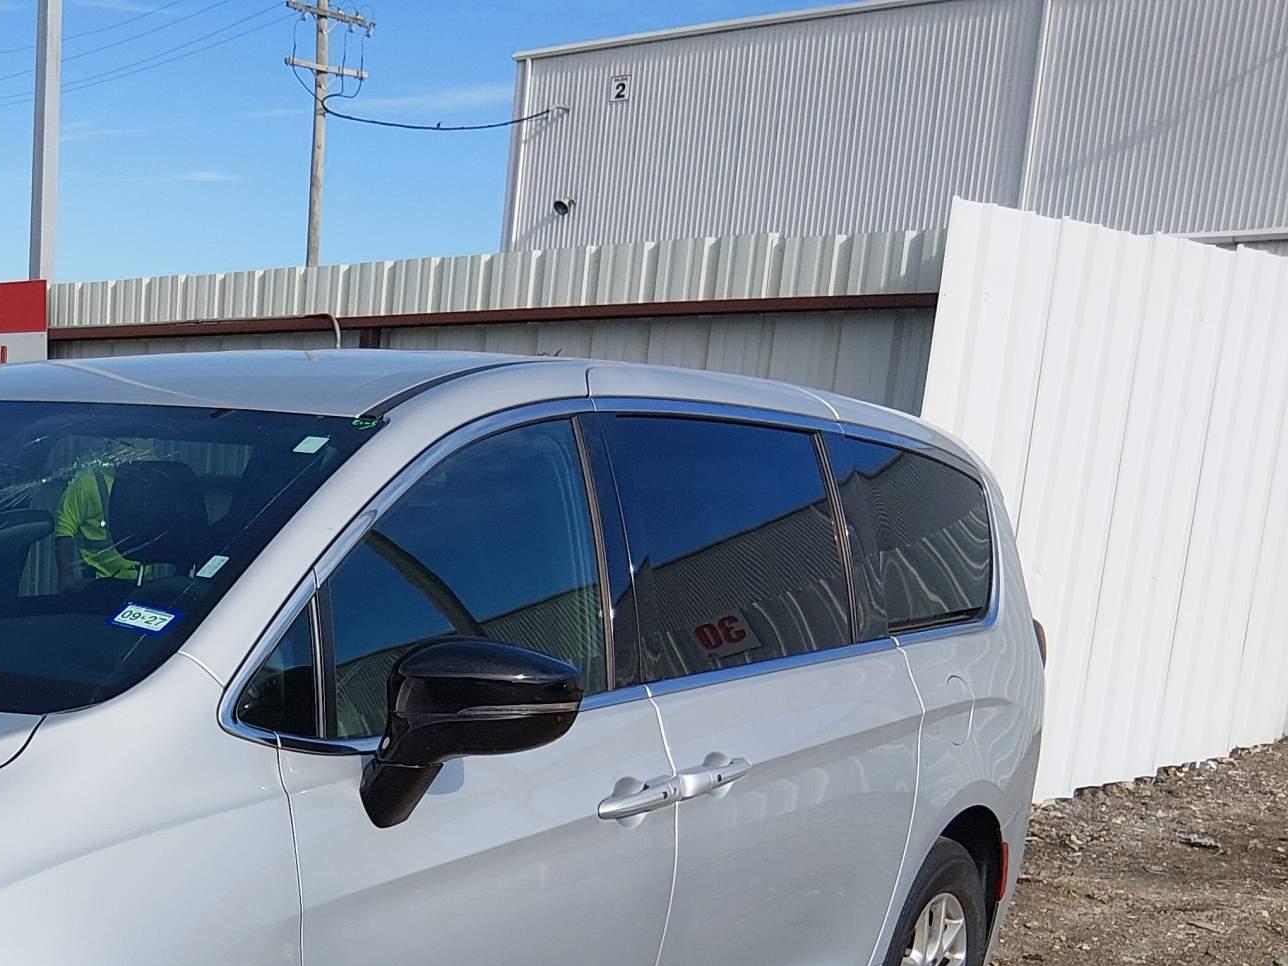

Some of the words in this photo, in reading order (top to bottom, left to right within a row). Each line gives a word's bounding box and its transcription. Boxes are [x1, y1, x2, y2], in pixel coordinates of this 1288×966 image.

[614, 83, 626, 99] 2
[121, 610, 142, 621] 09
[144, 615, 168, 626] 27
